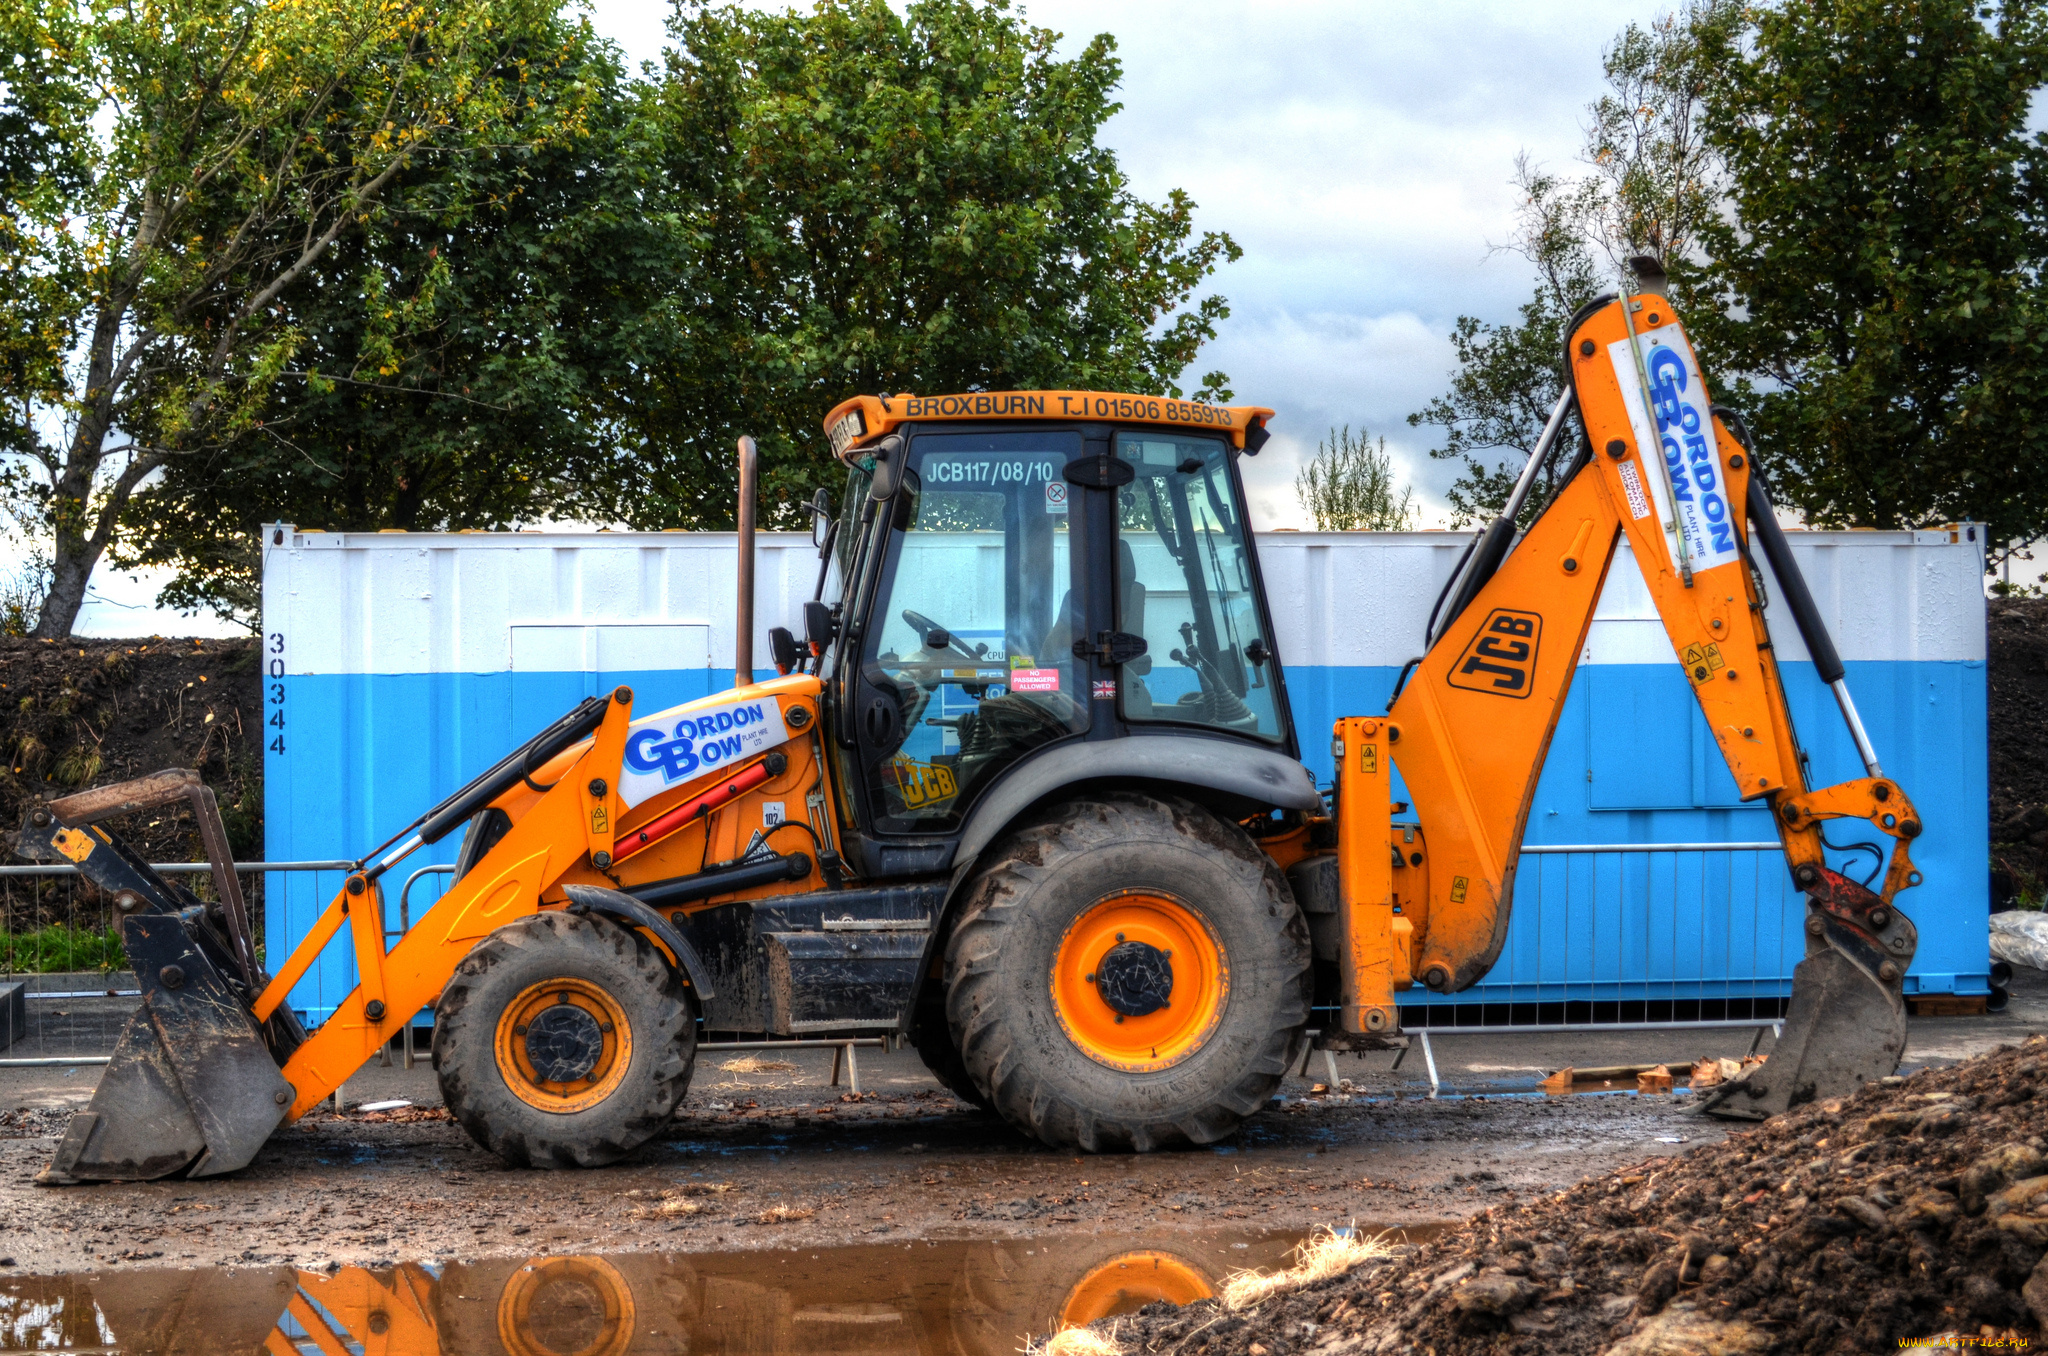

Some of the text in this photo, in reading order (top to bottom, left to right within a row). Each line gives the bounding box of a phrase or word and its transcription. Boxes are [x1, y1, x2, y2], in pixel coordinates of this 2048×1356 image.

[906, 396, 1044, 417] BROXBURN
[1095, 398, 1160, 420] 01506
[1166, 402, 1233, 426] 855913
[1641, 376, 1694, 502] BOW
[1647, 345, 1735, 555] GORDON
[927, 461, 1053, 486] JCB117/08/10
[1618, 464, 1640, 519] QUICK HITCH
[1623, 463, 1643, 516] AUTOMATIC
[1682, 525, 1692, 542] LTD
[1685, 504, 1706, 558] PLANT HIRE
[1460, 615, 1534, 690] JCB
[269, 633, 286, 756] 30344
[1013, 676, 1056, 684] PASSENGERS
[622, 704, 764, 775] GORDON
[650, 733, 742, 785] BOW
[742, 731, 757, 741] PLANT
[753, 738, 763, 746] LTD
[905, 764, 953, 803] JCB
[765, 812, 779, 825] 102
